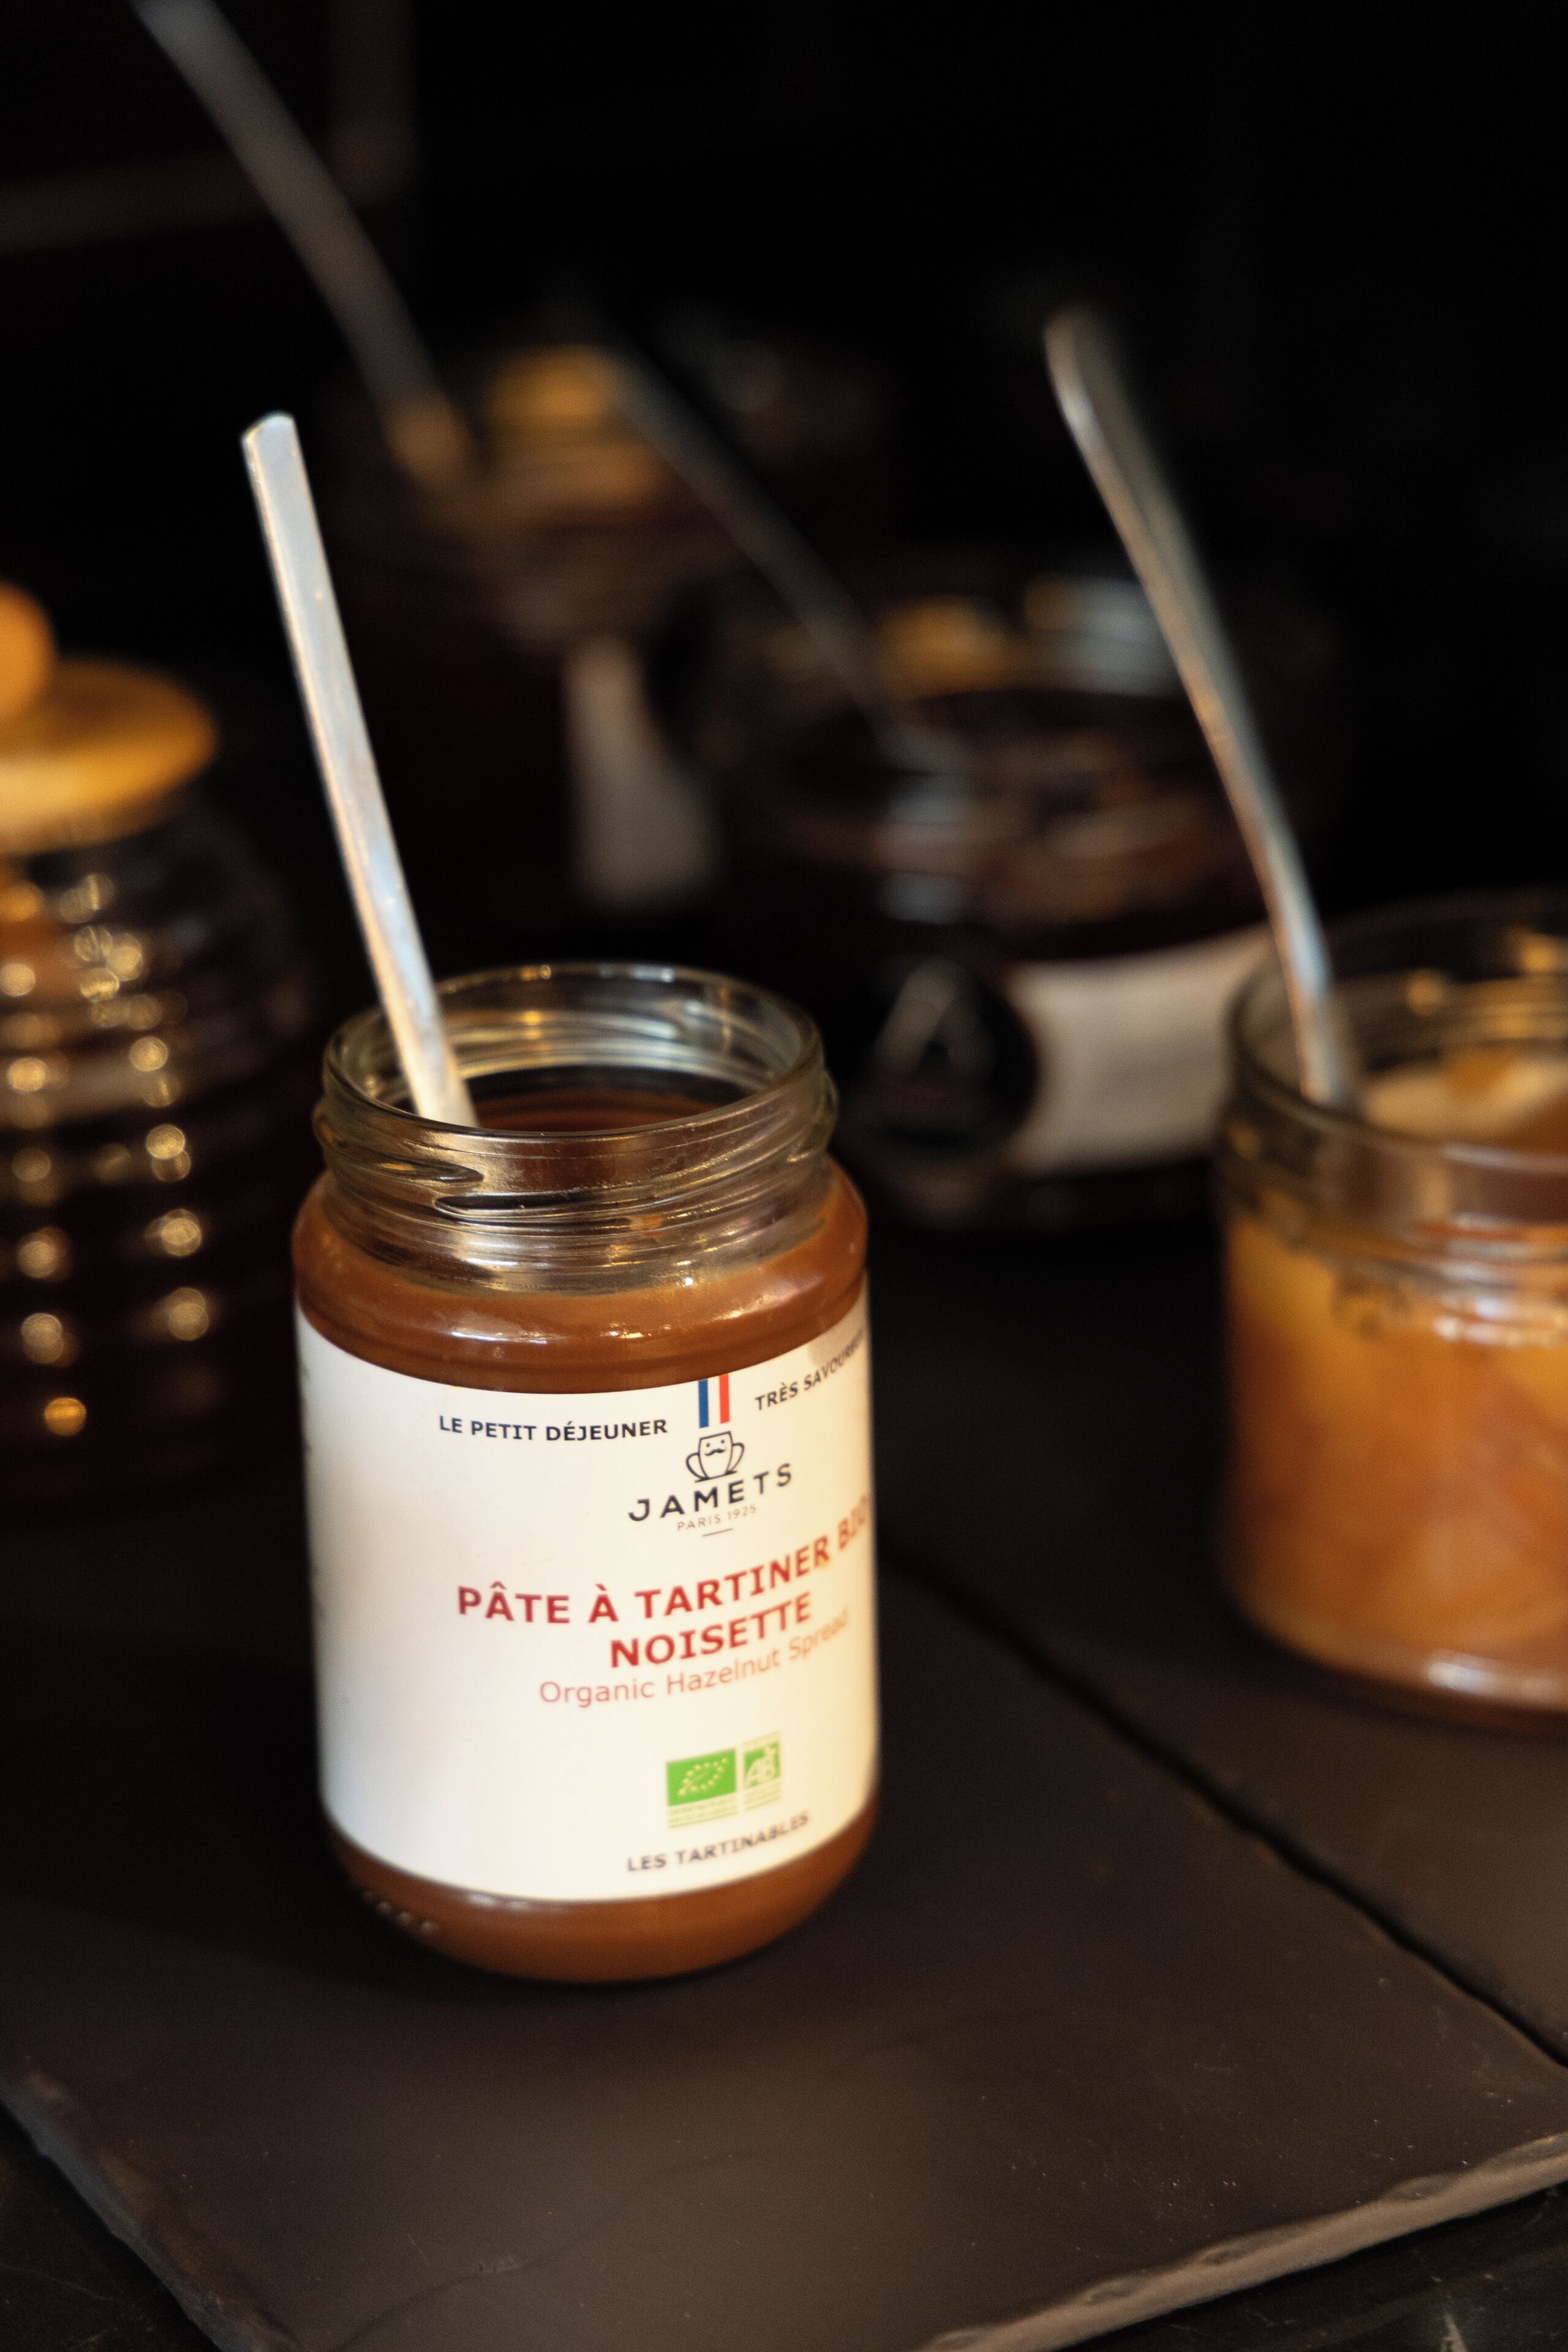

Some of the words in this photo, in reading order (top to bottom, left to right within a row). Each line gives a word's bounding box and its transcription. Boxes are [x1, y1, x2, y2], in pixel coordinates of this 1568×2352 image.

[755, 1382, 799, 1410] TRÈS
[439, 1415, 463, 1434] LE
[470, 1420, 537, 1441] PETIT
[546, 1418, 668, 1441] DÉJEUNER
[628, 1462, 792, 1522] JAMETS
[677, 1513, 722, 1531] PARIS
[727, 1504, 757, 1520] 1925
[458, 1581, 570, 1624] PÂTE
[588, 1584, 619, 1623] À
[635, 1535, 830, 1619] TARTINER
[539, 1678, 655, 1708] Organic
[667, 1649, 780, 1695] Hazelnut
[788, 1605, 849, 1660] Spread
[611, 1592, 811, 1668] NOISETTE
[628, 1854, 666, 1871] LES
[676, 1809, 809, 1864] TARTINABLES
